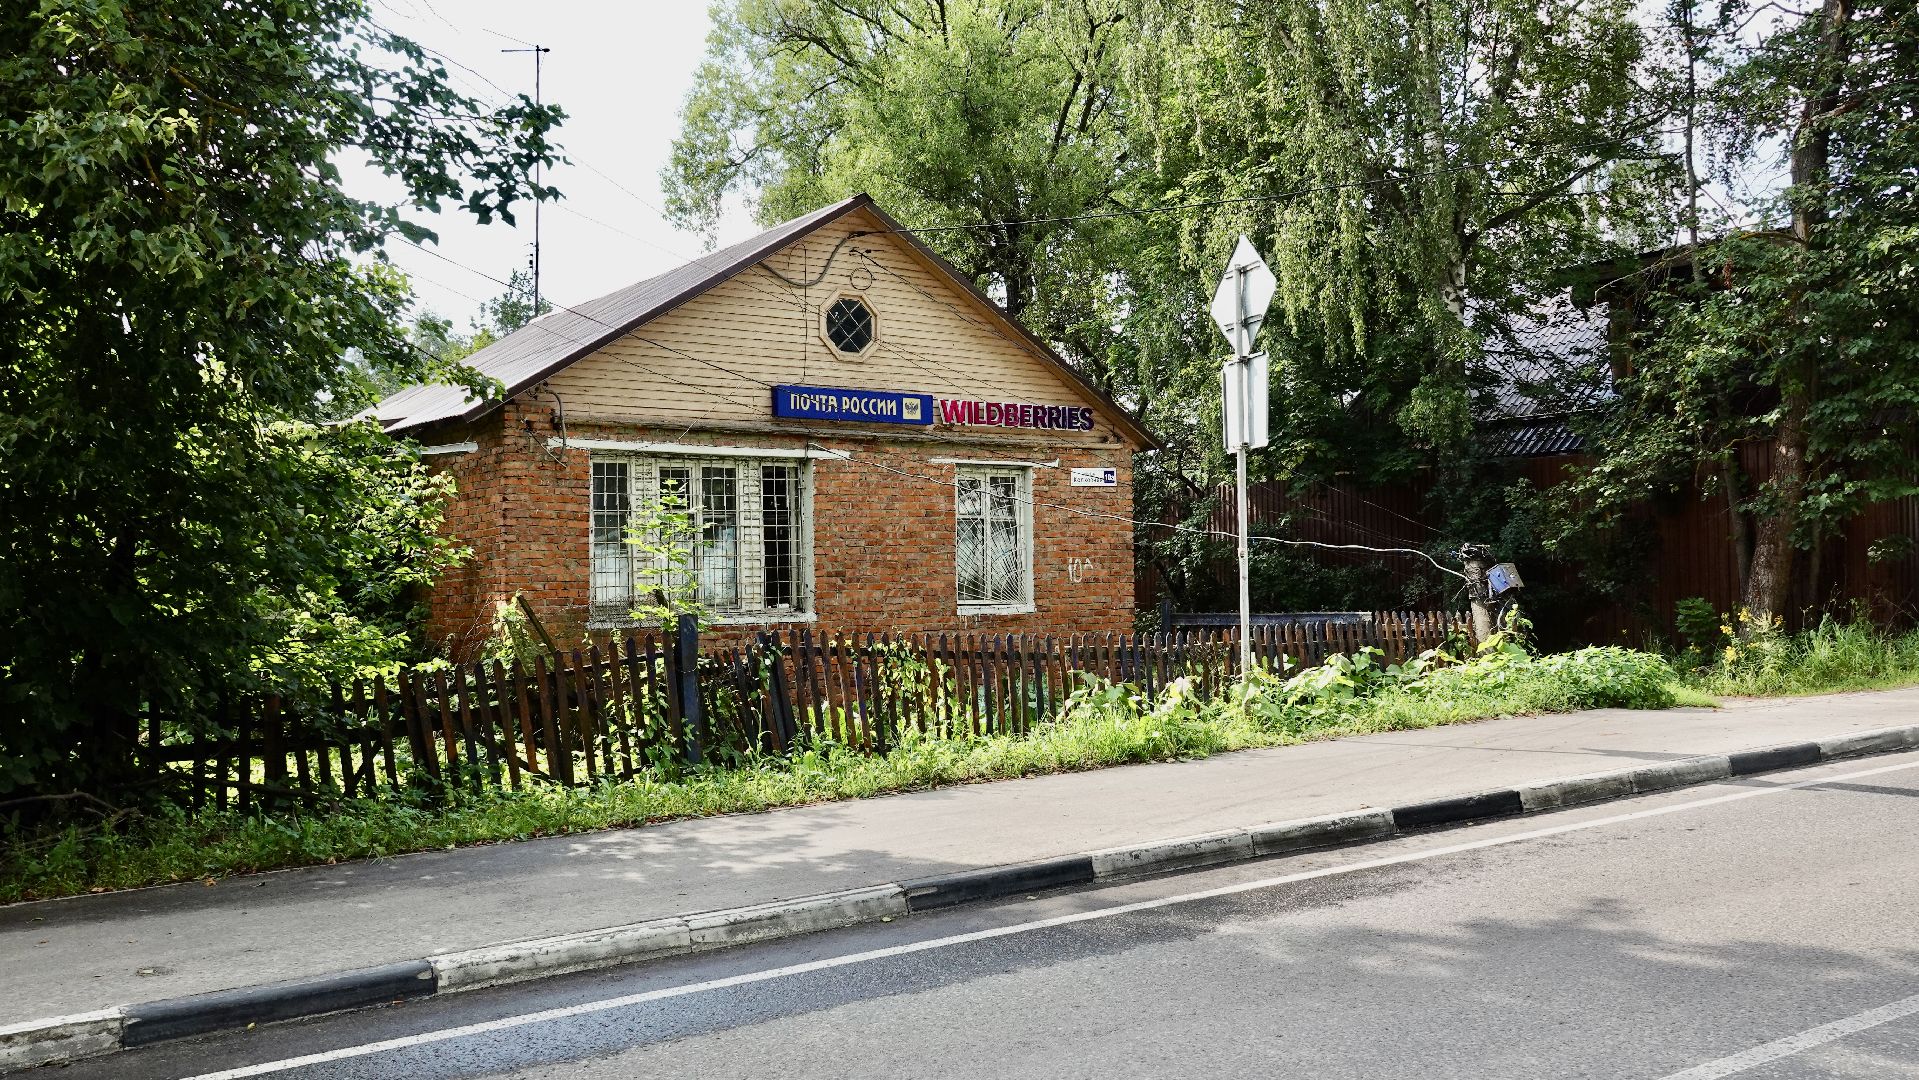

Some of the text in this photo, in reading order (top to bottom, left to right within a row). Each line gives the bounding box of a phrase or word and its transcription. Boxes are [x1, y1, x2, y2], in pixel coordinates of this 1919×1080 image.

[790, 393, 897, 416] ПОЧТА РОССИИ
[939, 399, 1095, 431] WILDBERRIES
